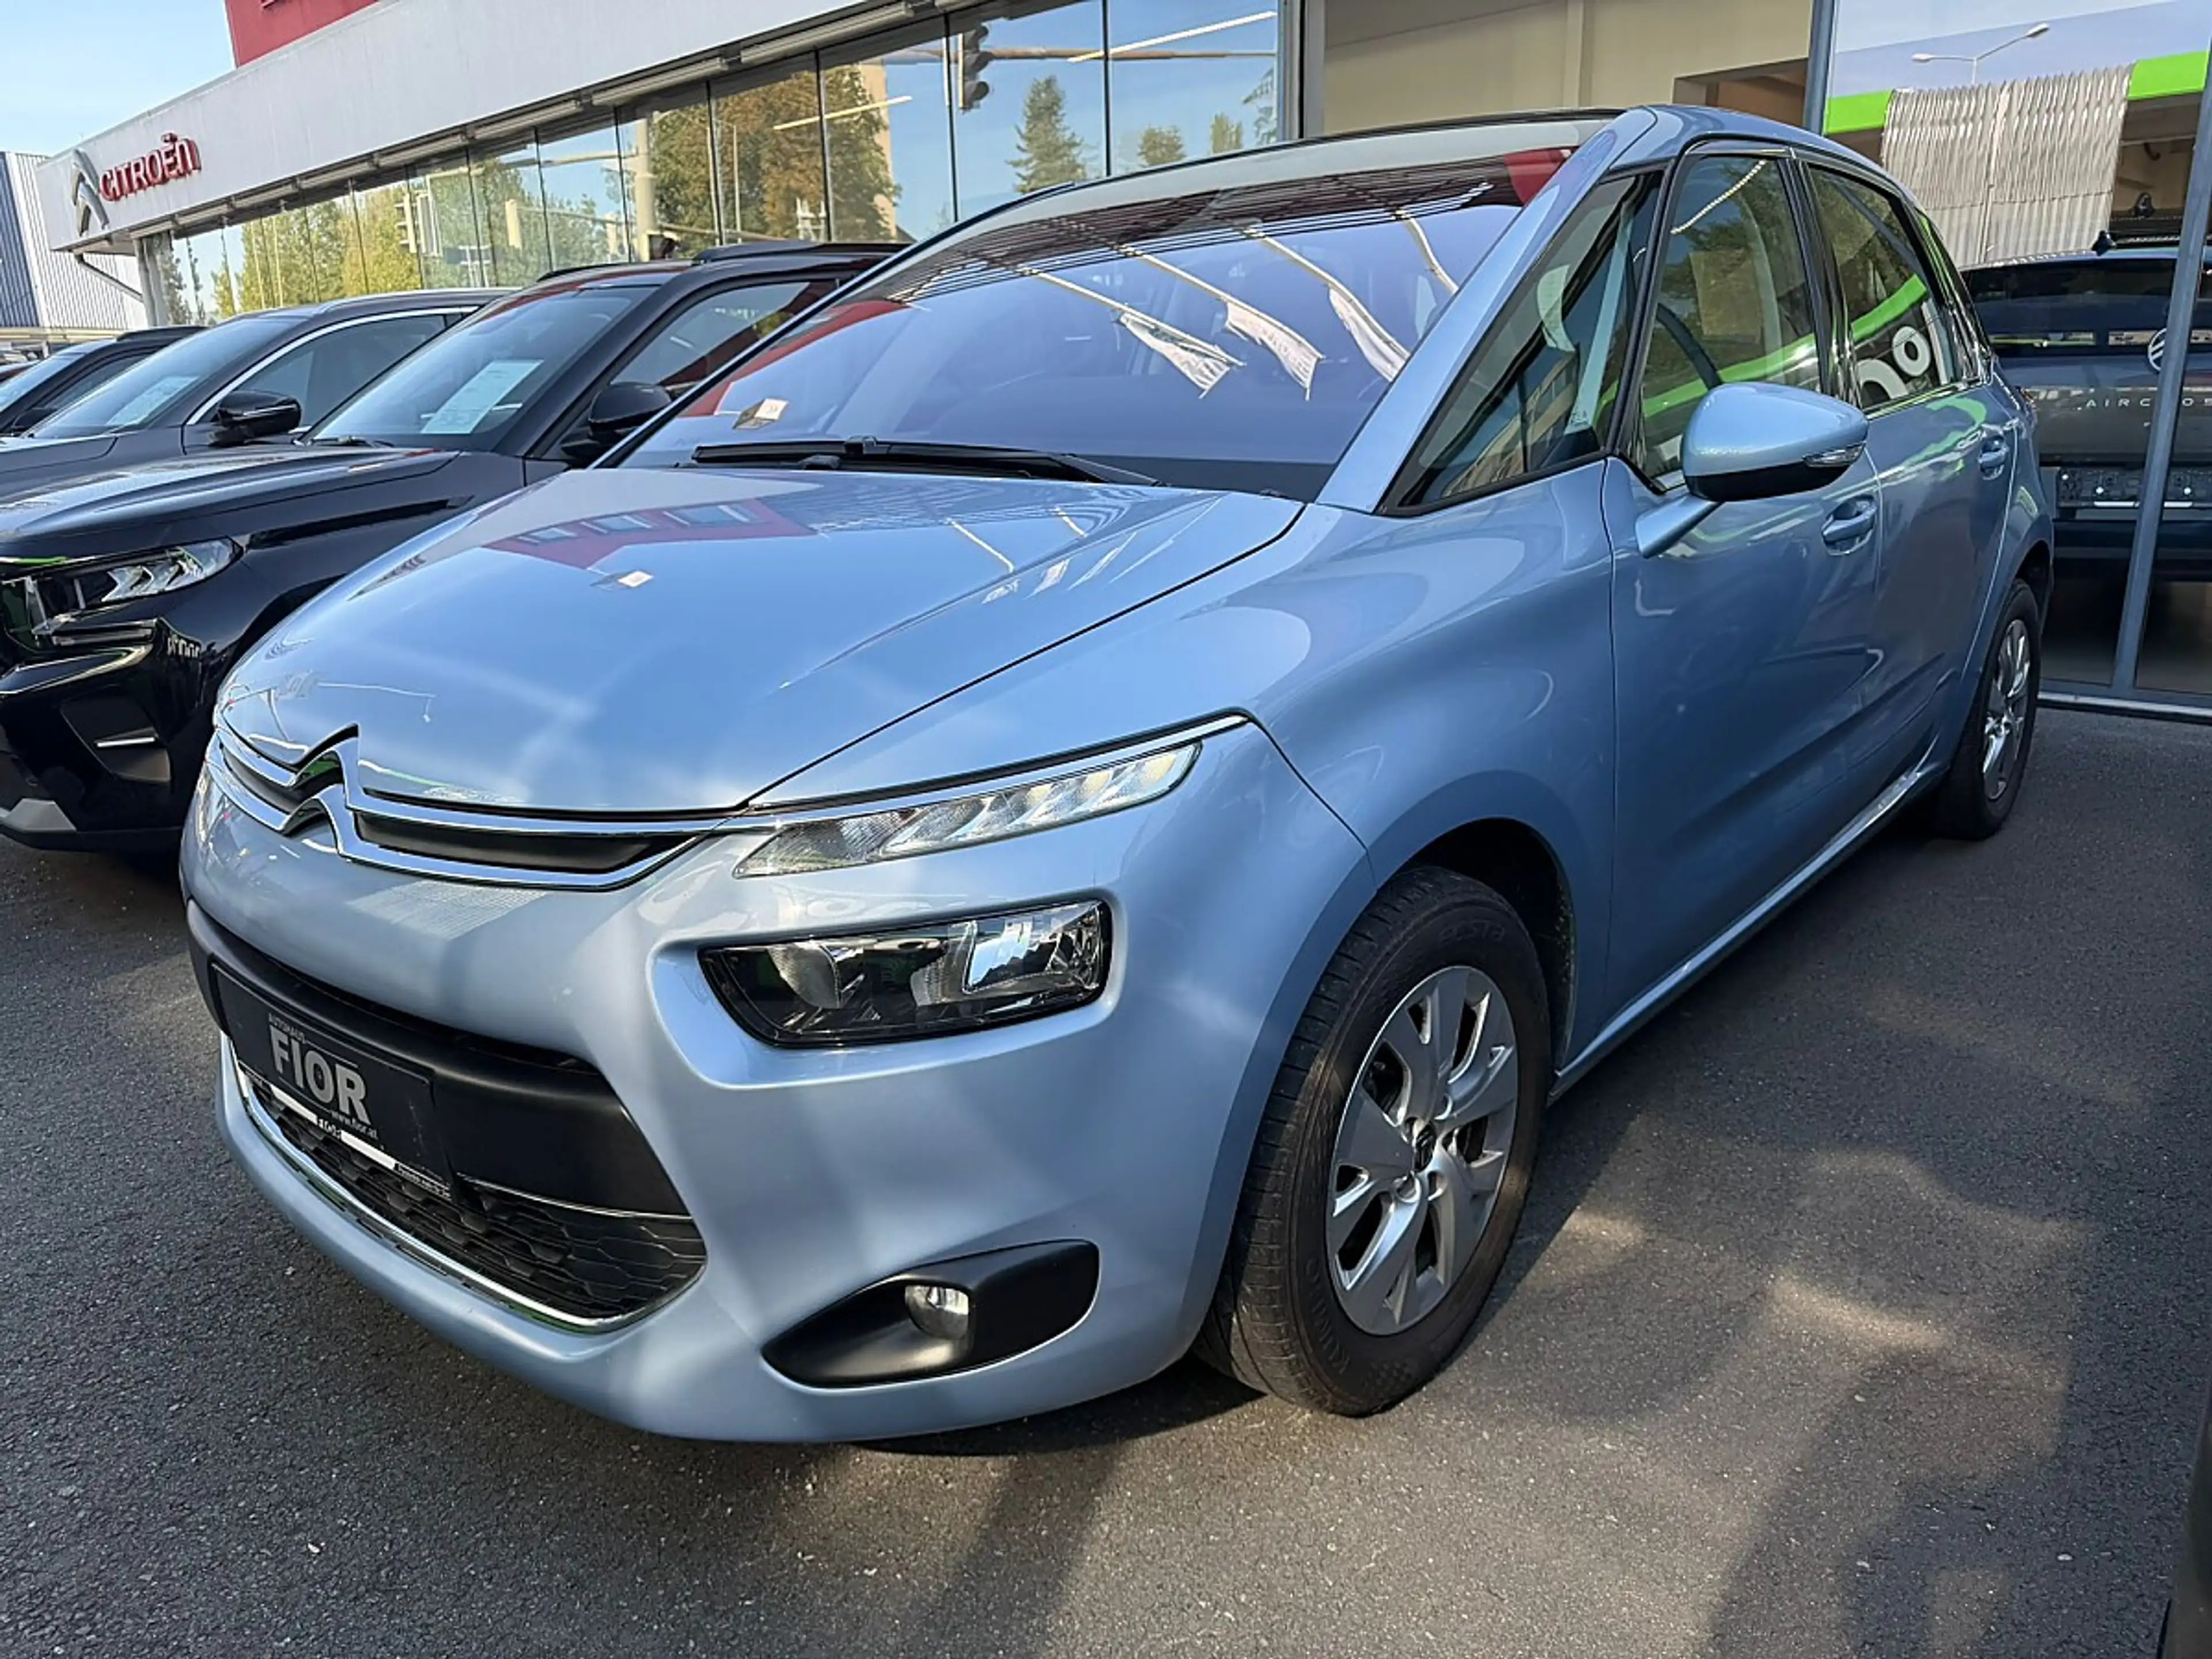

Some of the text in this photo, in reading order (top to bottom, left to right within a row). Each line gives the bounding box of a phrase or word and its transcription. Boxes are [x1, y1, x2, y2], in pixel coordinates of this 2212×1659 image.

[100, 132, 200, 202] CITROËN
[2086, 397, 2212, 407] AIRCOS
[269, 1024, 372, 1126] FIOR
